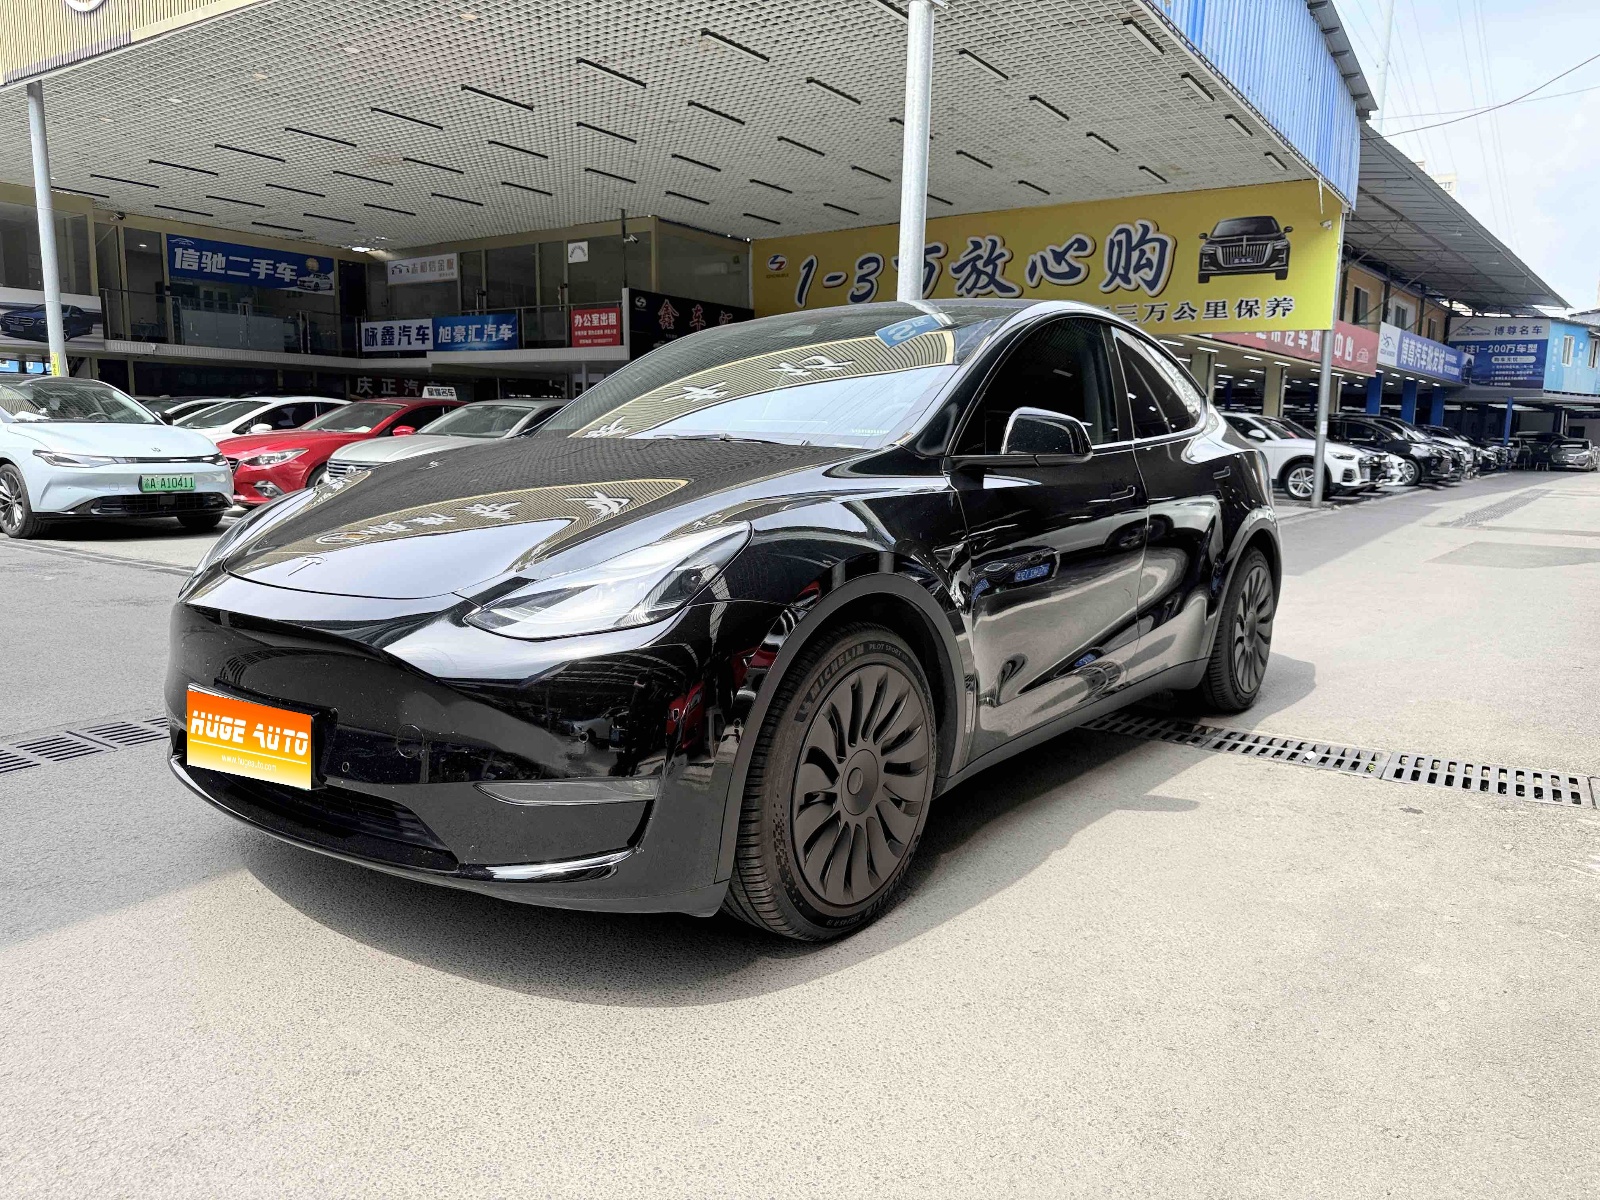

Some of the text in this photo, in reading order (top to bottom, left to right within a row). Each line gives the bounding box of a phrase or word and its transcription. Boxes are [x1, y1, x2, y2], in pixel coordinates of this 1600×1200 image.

[174, 247, 298, 282] 信驰二手车
[574, 312, 617, 327] 办公室出租
[1100, 297, 1295, 324] 三万公里保养
[364, 325, 430, 347] 咏鑫汽车
[438, 324, 514, 343] 旭豪汇汽车
[1494, 325, 1543, 336] 博尊名车
[356, 376, 440, 396] 庆正汽
[809, 643, 865, 700] MICHELIN
